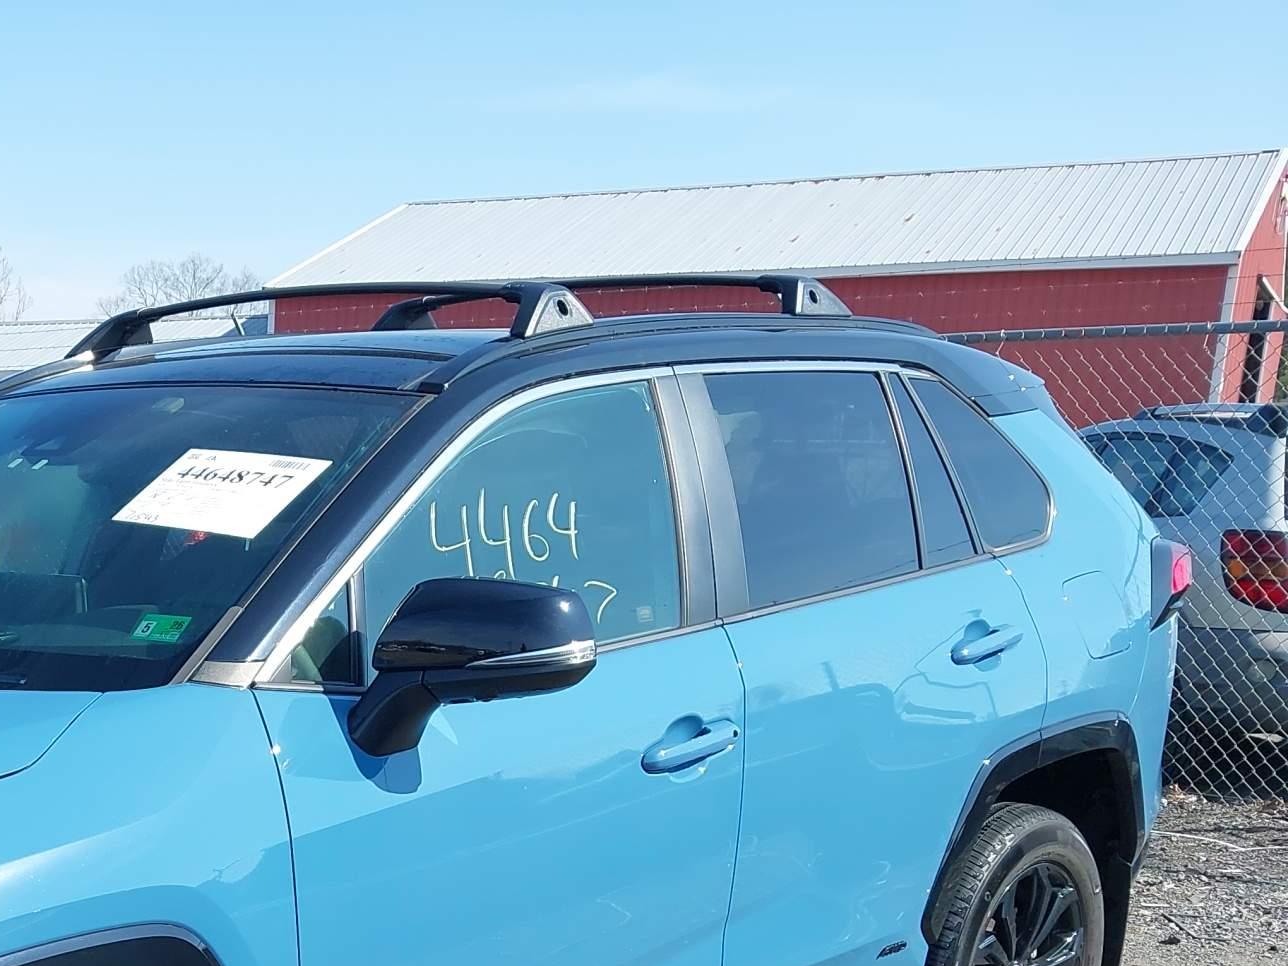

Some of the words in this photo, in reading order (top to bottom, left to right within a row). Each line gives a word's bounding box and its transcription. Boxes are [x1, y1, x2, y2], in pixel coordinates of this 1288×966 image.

[177, 465, 296, 489] 44648747
[429, 486, 580, 580] 4464
[141, 622, 154, 634] 5
